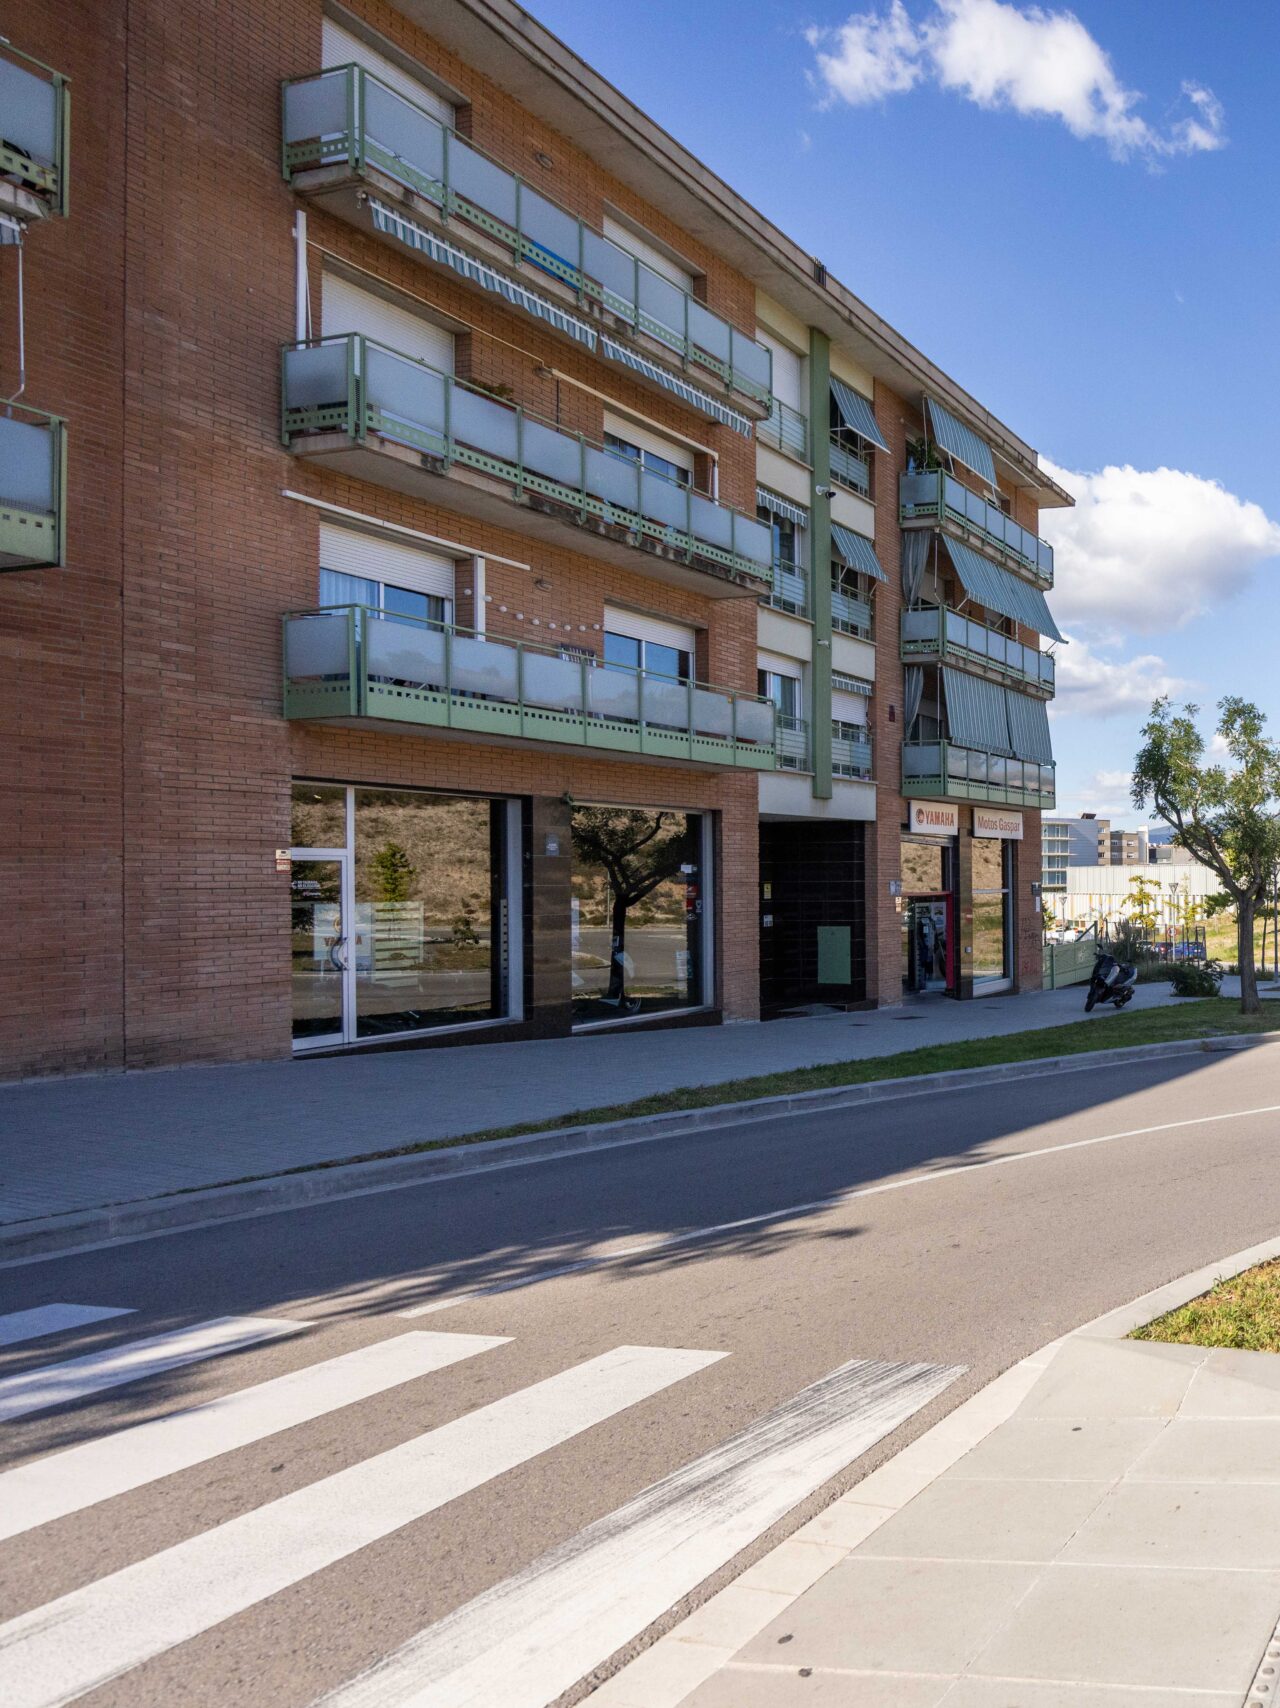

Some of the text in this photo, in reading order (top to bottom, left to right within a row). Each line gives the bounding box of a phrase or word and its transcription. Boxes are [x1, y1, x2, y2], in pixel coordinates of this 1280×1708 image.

[925, 810, 955, 826] YAMAHA
[977, 815, 1021, 834] Motos Gaspar
